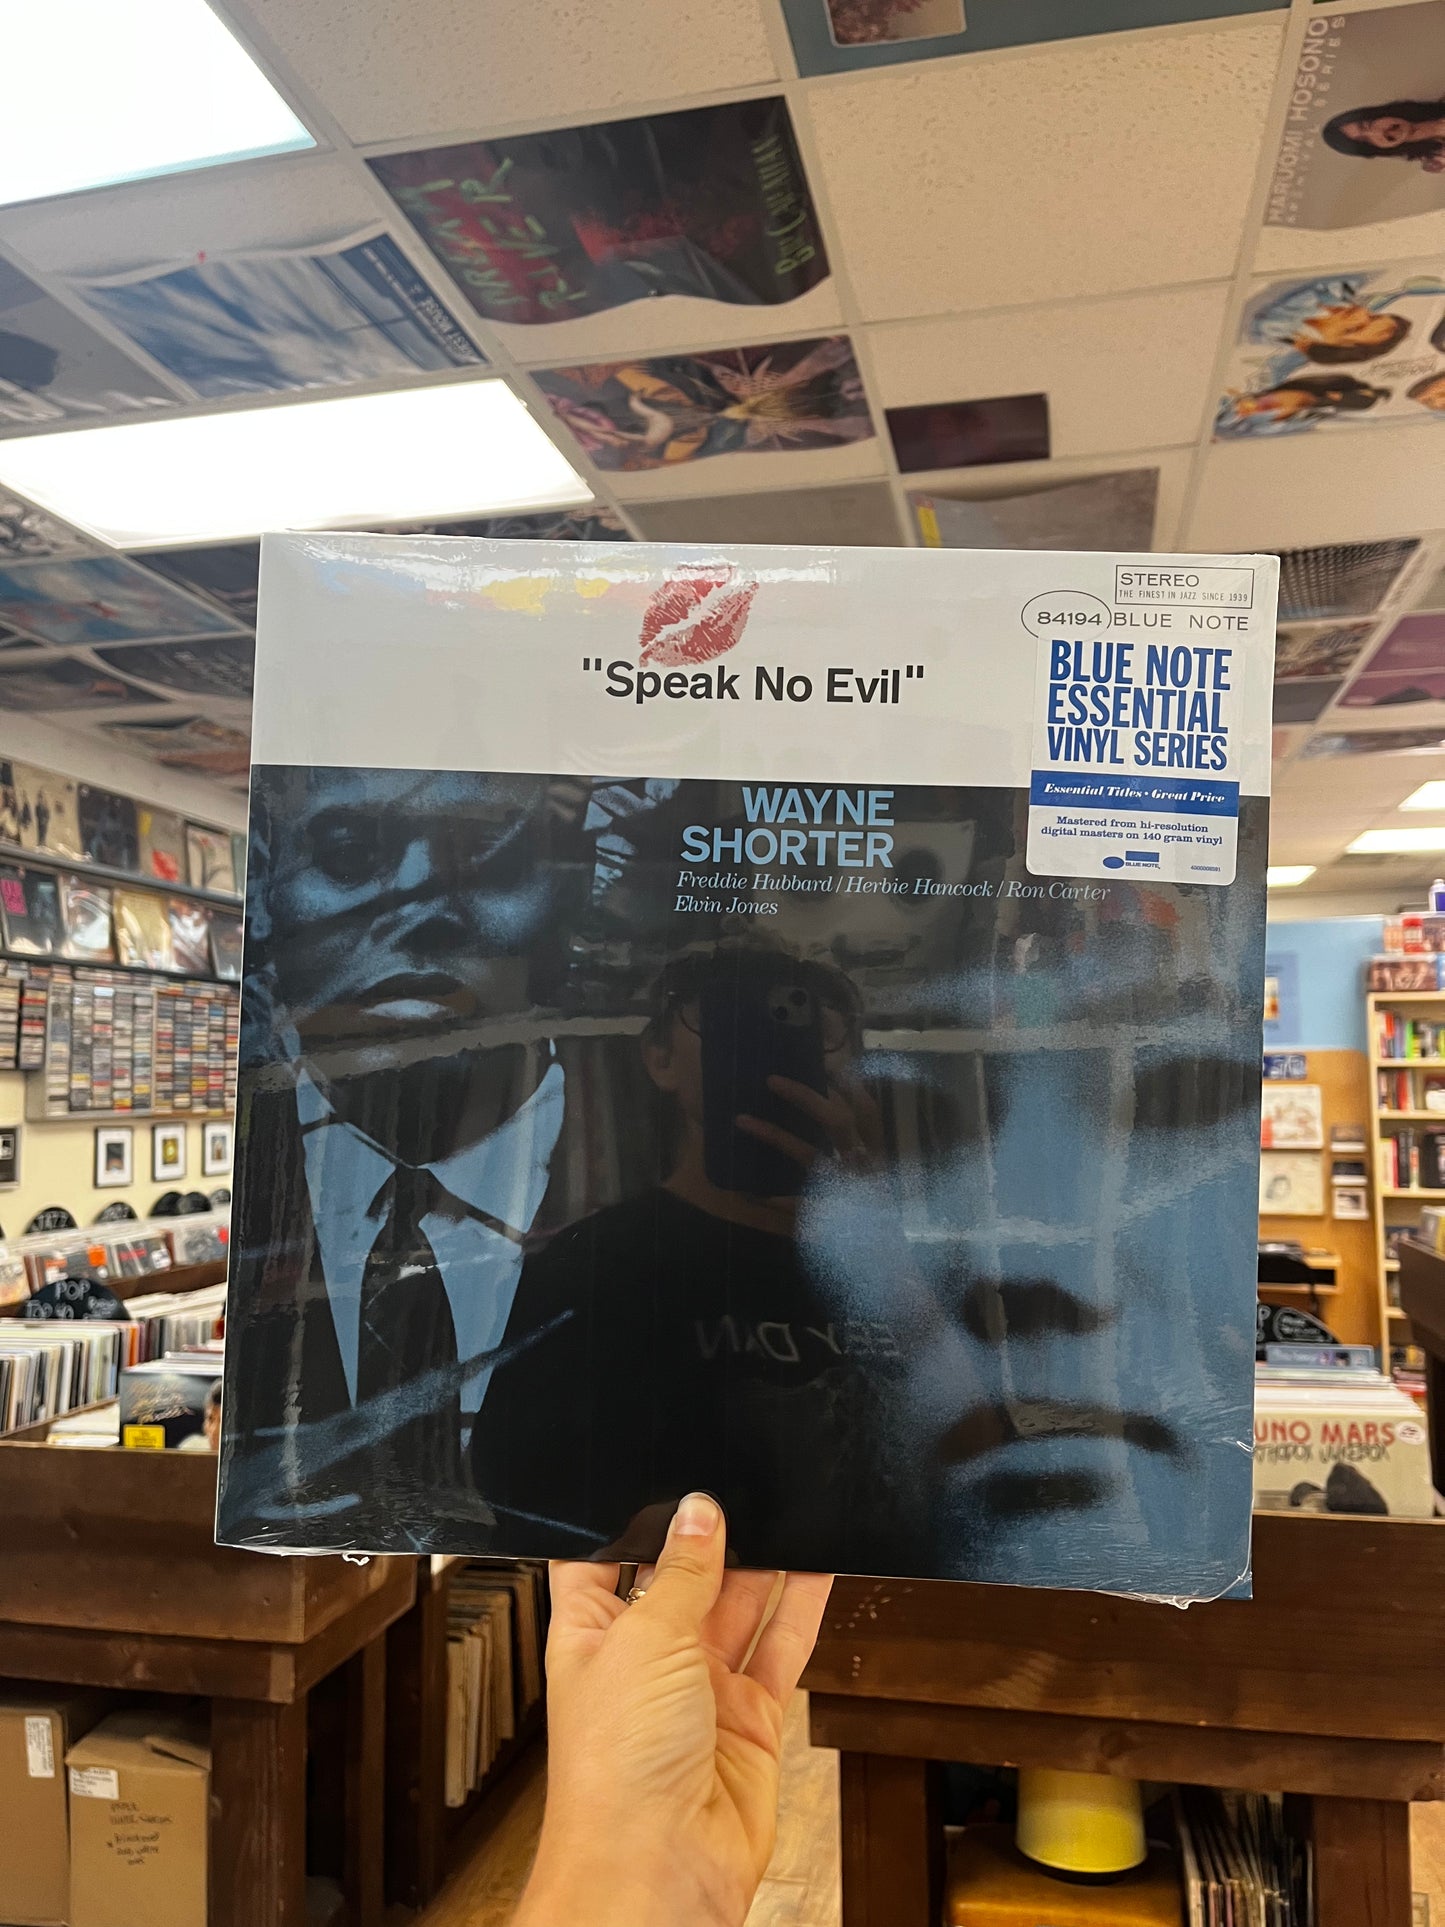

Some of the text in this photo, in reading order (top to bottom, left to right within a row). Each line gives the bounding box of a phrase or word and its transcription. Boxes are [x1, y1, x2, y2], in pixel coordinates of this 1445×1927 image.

[1289, 18, 1328, 121] HOSONO
[1313, 16, 1346, 107] SERIES
[459, 157, 588, 310] RIVER
[1120, 572, 1200, 588] STEREO
[1118, 589, 1249, 602] THE FINEST IN JAZZ SINCE 1939
[1037, 610, 1103, 626] 84194
[1112, 611, 1250, 631] BLUE NOTE
[1049, 639, 1233, 691] BLUE NOTE
[582, 657, 925, 704] "Speak No Evil"
[1047, 682, 1229, 734] ESSENTIAL
[1047, 726, 1228, 771] VINYL SERIES
[741, 786, 895, 827] WAYNE
[1043, 783, 1225, 804] Essential Titles Great Price
[1041, 826, 1223, 846] digital masters on 140 gram vinyl
[1056, 816, 1209, 833] Mastered from hi-resolution
[680, 825, 894, 869] SHORTER
[676, 870, 748, 890] Freddie
[751, 873, 833, 893] Hubbard
[846, 876, 909, 895] Herbie
[912, 878, 993, 898] Hancock
[1006, 880, 1045, 898] Ron
[1048, 882, 1111, 901] Carter
[673, 895, 779, 915] Elvin Jones
[54, 1279, 91, 1301] POP
[1254, 1420, 1311, 1444] UNO
[1320, 1421, 1396, 1446] MARS
